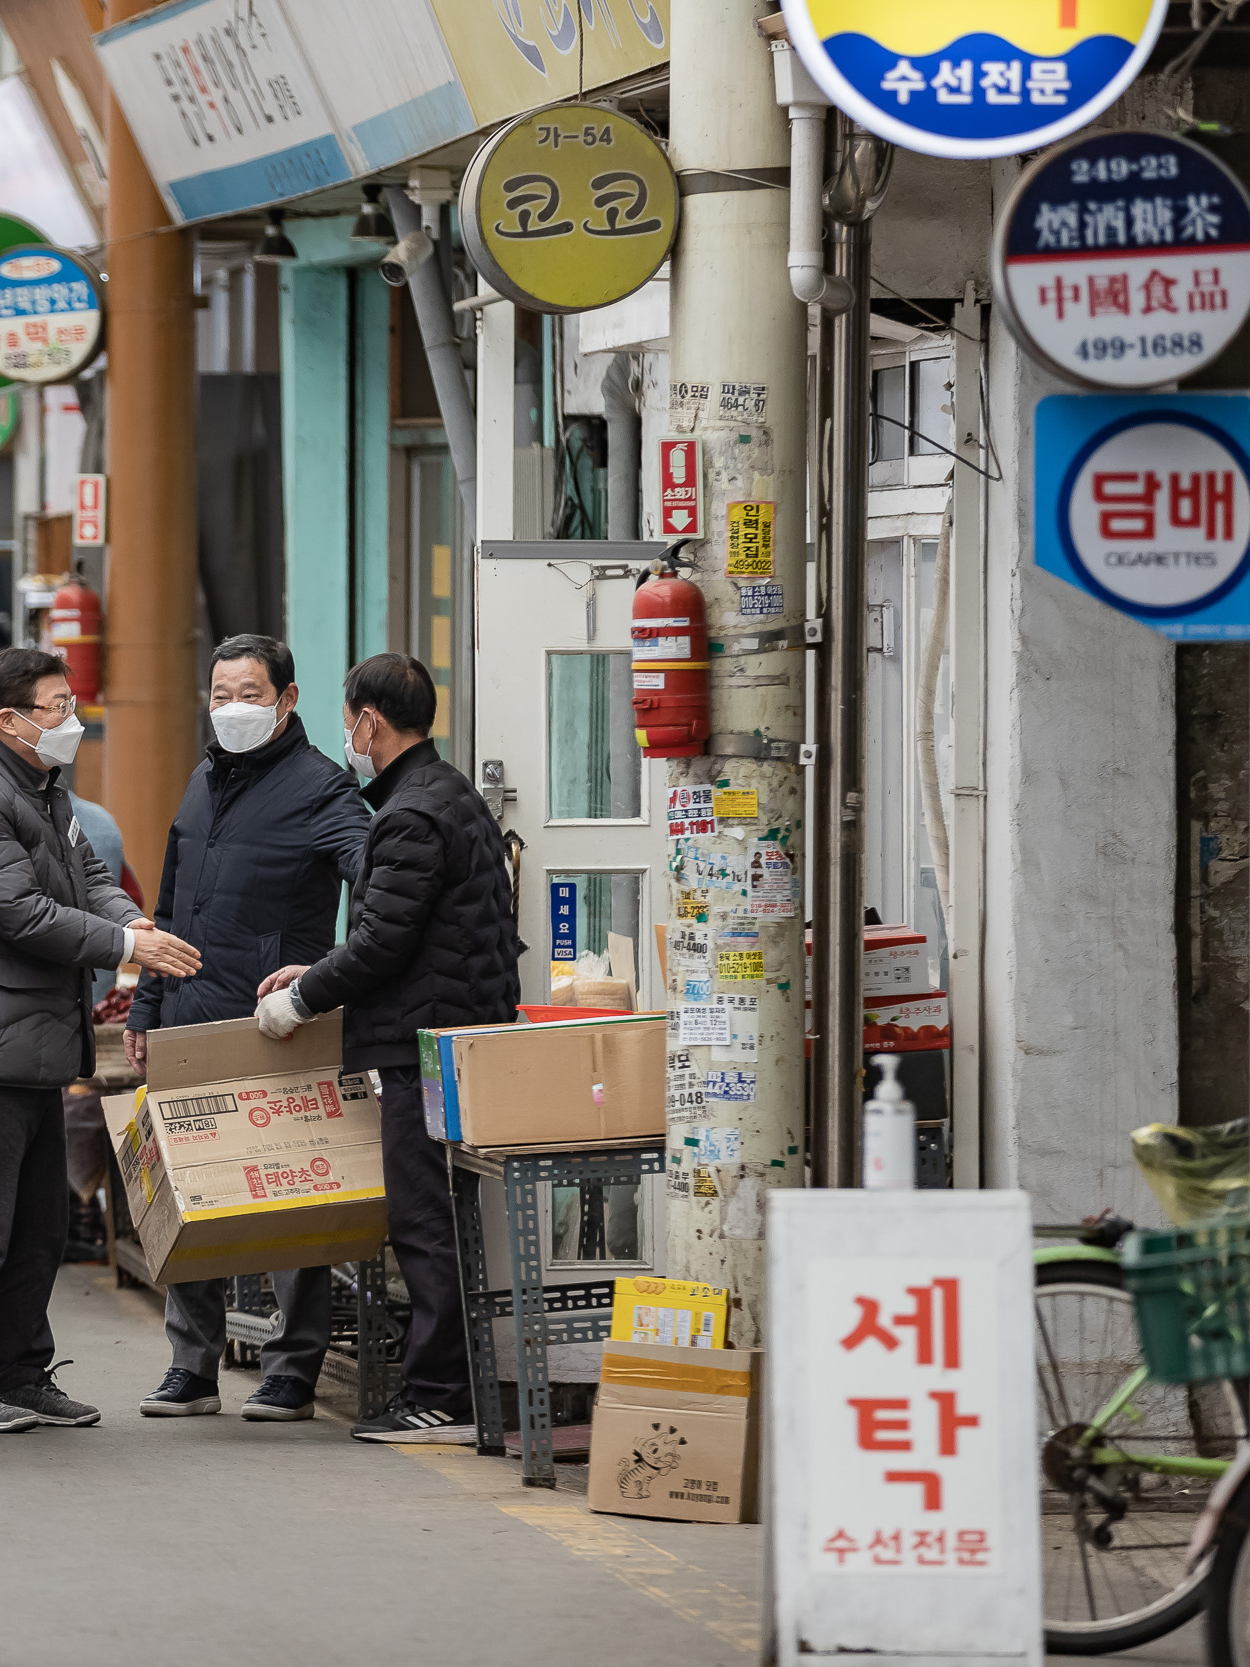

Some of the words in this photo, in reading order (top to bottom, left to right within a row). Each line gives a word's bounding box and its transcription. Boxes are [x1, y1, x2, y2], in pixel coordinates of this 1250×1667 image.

[880, 58, 1072, 105] 수선전문
[537, 125, 613, 148] 가-54
[1069, 154, 1179, 184] 249-23
[494, 171, 662, 239] 코코
[1038, 267, 1228, 321] 中國食品
[24, 320, 50, 347] 떡
[1075, 331, 1204, 361] 499-1688
[690, 385, 710, 399] 모집
[663, 487, 696, 499] 소화기
[1091, 470, 1235, 541] 담배
[742, 504, 760, 558] 인력모집
[734, 560, 772, 571] 499-0022
[692, 789, 713, 805] 화물
[558, 886, 570, 933] 미세요
[556, 949, 573, 957] VISA
[889, 949, 920, 959] 충주사과
[718, 961, 764, 974] 010-5219-1009
[899, 1005, 943, 1019] 충주사과
[250, 1090, 264, 1100] 500
[707, 1082, 756, 1095] 447-3530
[267, 1095, 320, 1117] 태양초
[265, 1167, 314, 1187] 태양초
[839, 1276, 981, 1512] 세탁
[822, 1527, 992, 1568] 수선전문
